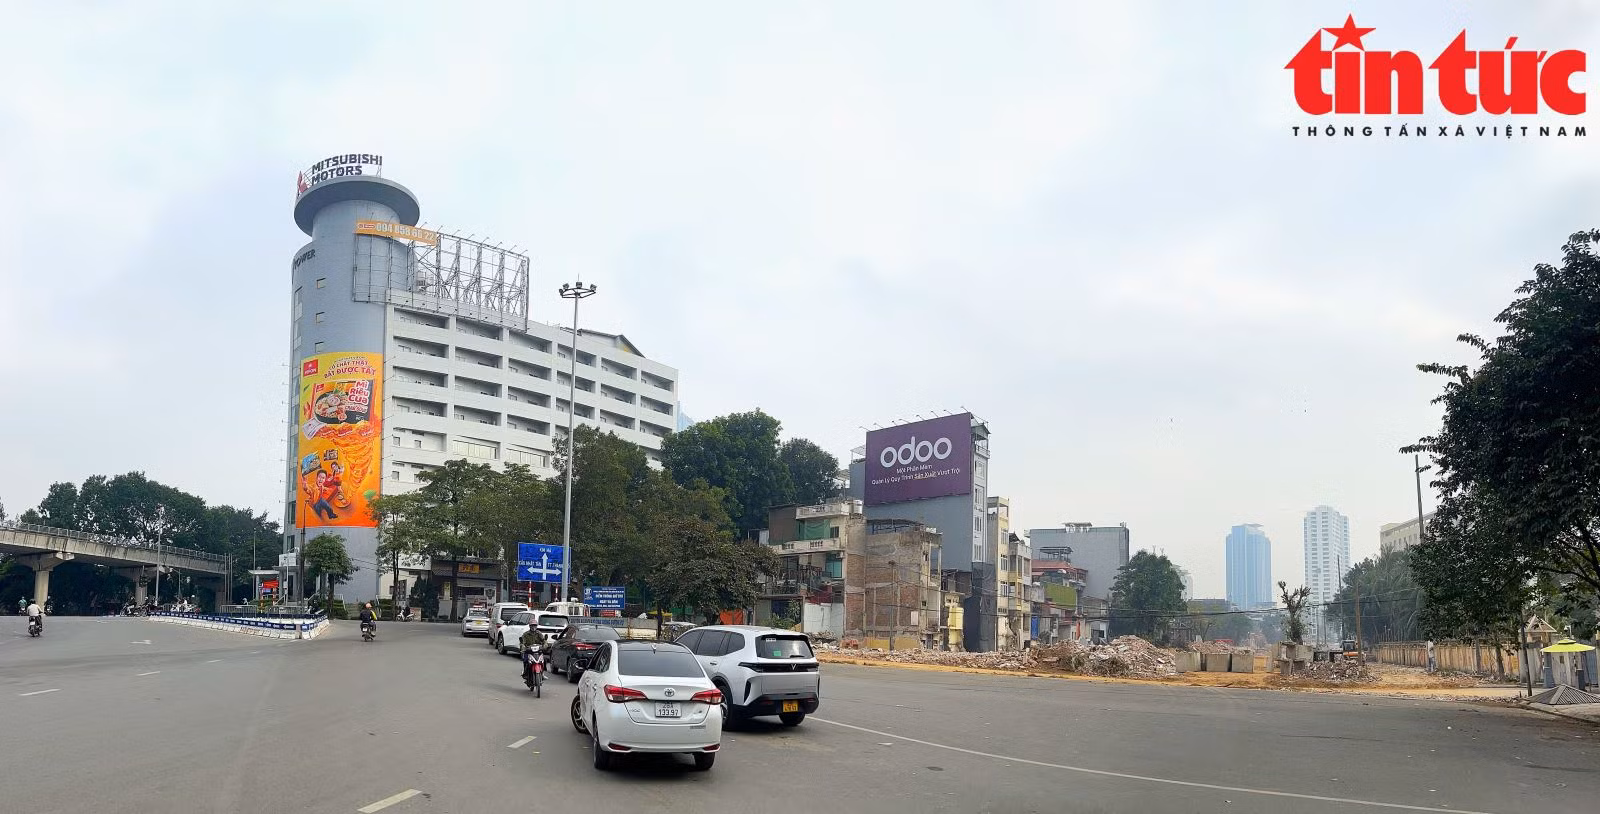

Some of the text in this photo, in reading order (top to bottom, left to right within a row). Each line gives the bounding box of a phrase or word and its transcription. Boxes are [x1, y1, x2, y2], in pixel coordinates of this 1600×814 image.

[311, 153, 383, 175] MITSUBISHI
[311, 165, 362, 186] MOTORS
[336, 366, 359, 375] ĐƯỢC
[880, 436, 953, 468] odoo
